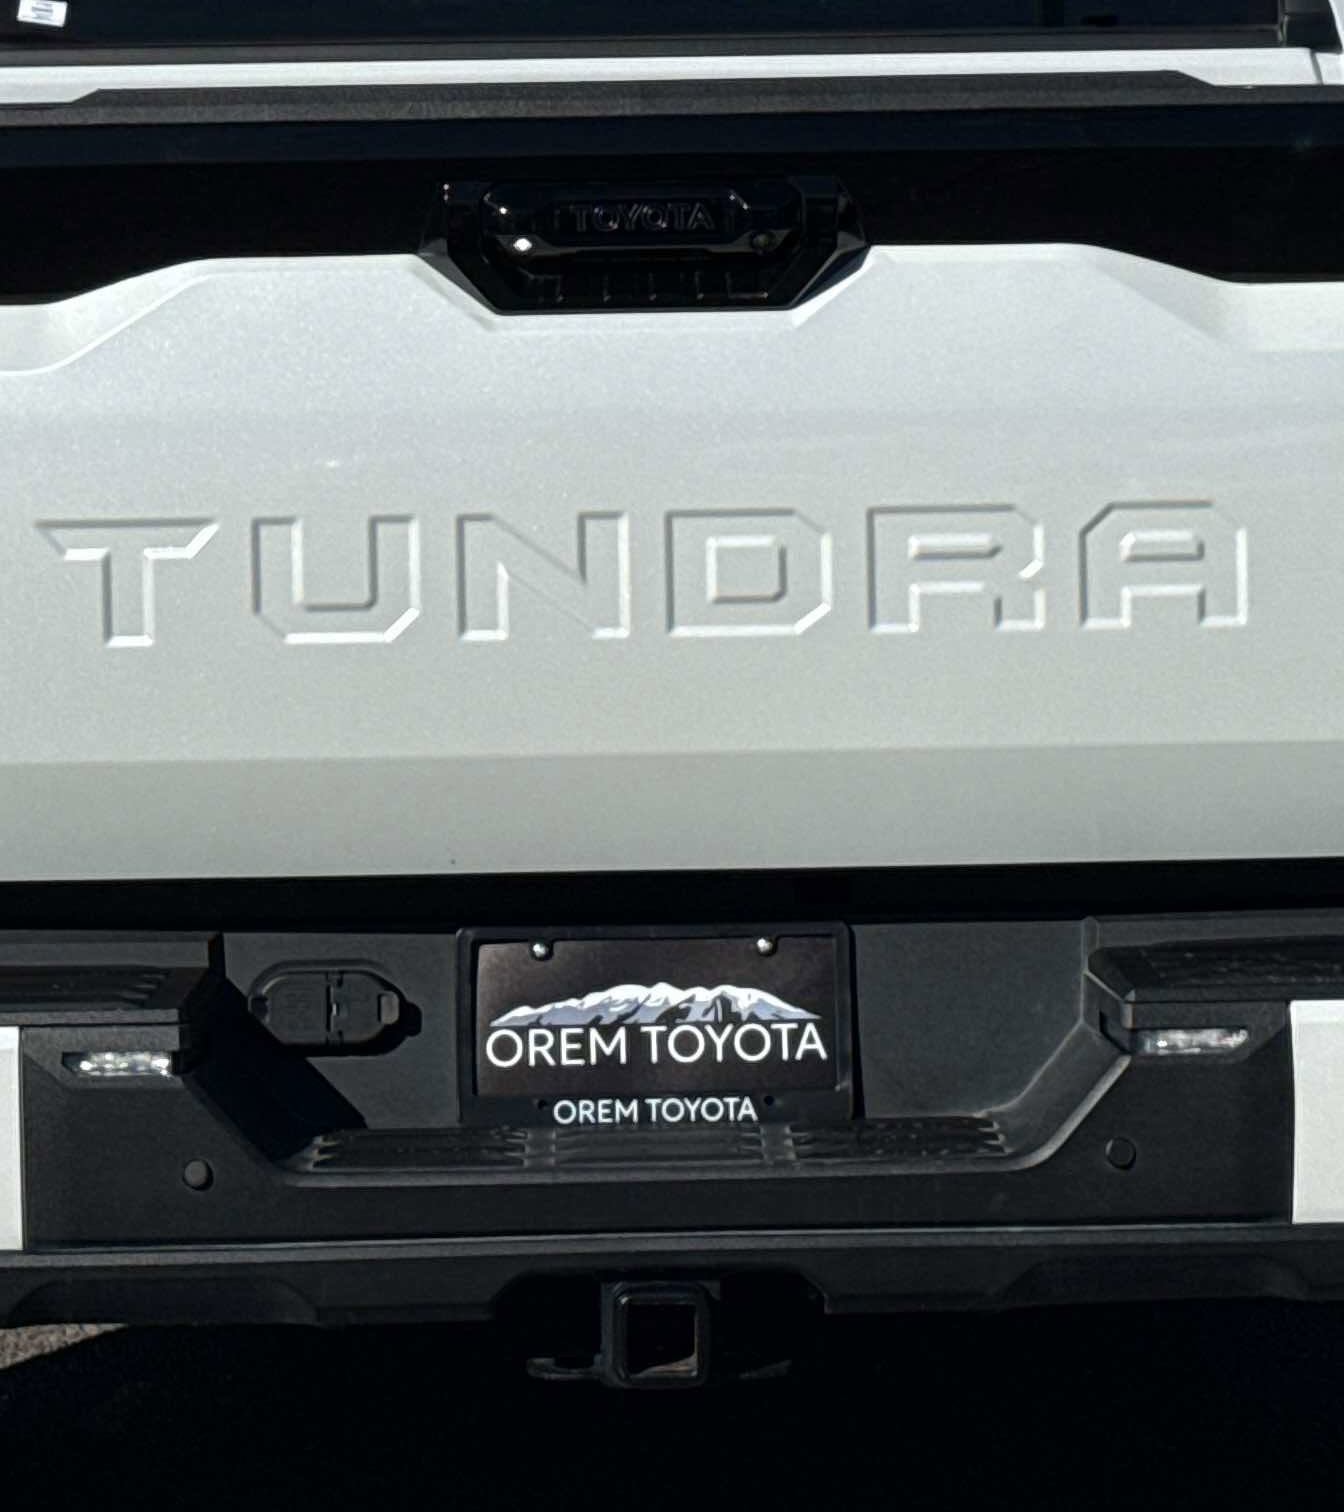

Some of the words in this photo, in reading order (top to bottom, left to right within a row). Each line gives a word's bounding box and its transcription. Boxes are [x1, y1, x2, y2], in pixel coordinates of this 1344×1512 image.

[572, 201, 715, 232] TOYOTA
[34, 500, 1249, 647] TUNDRA
[485, 1026, 627, 1068] OREM
[640, 1022, 828, 1064] TOYOTA
[554, 1098, 638, 1125] OREM
[645, 1096, 758, 1123] TOYOTA
